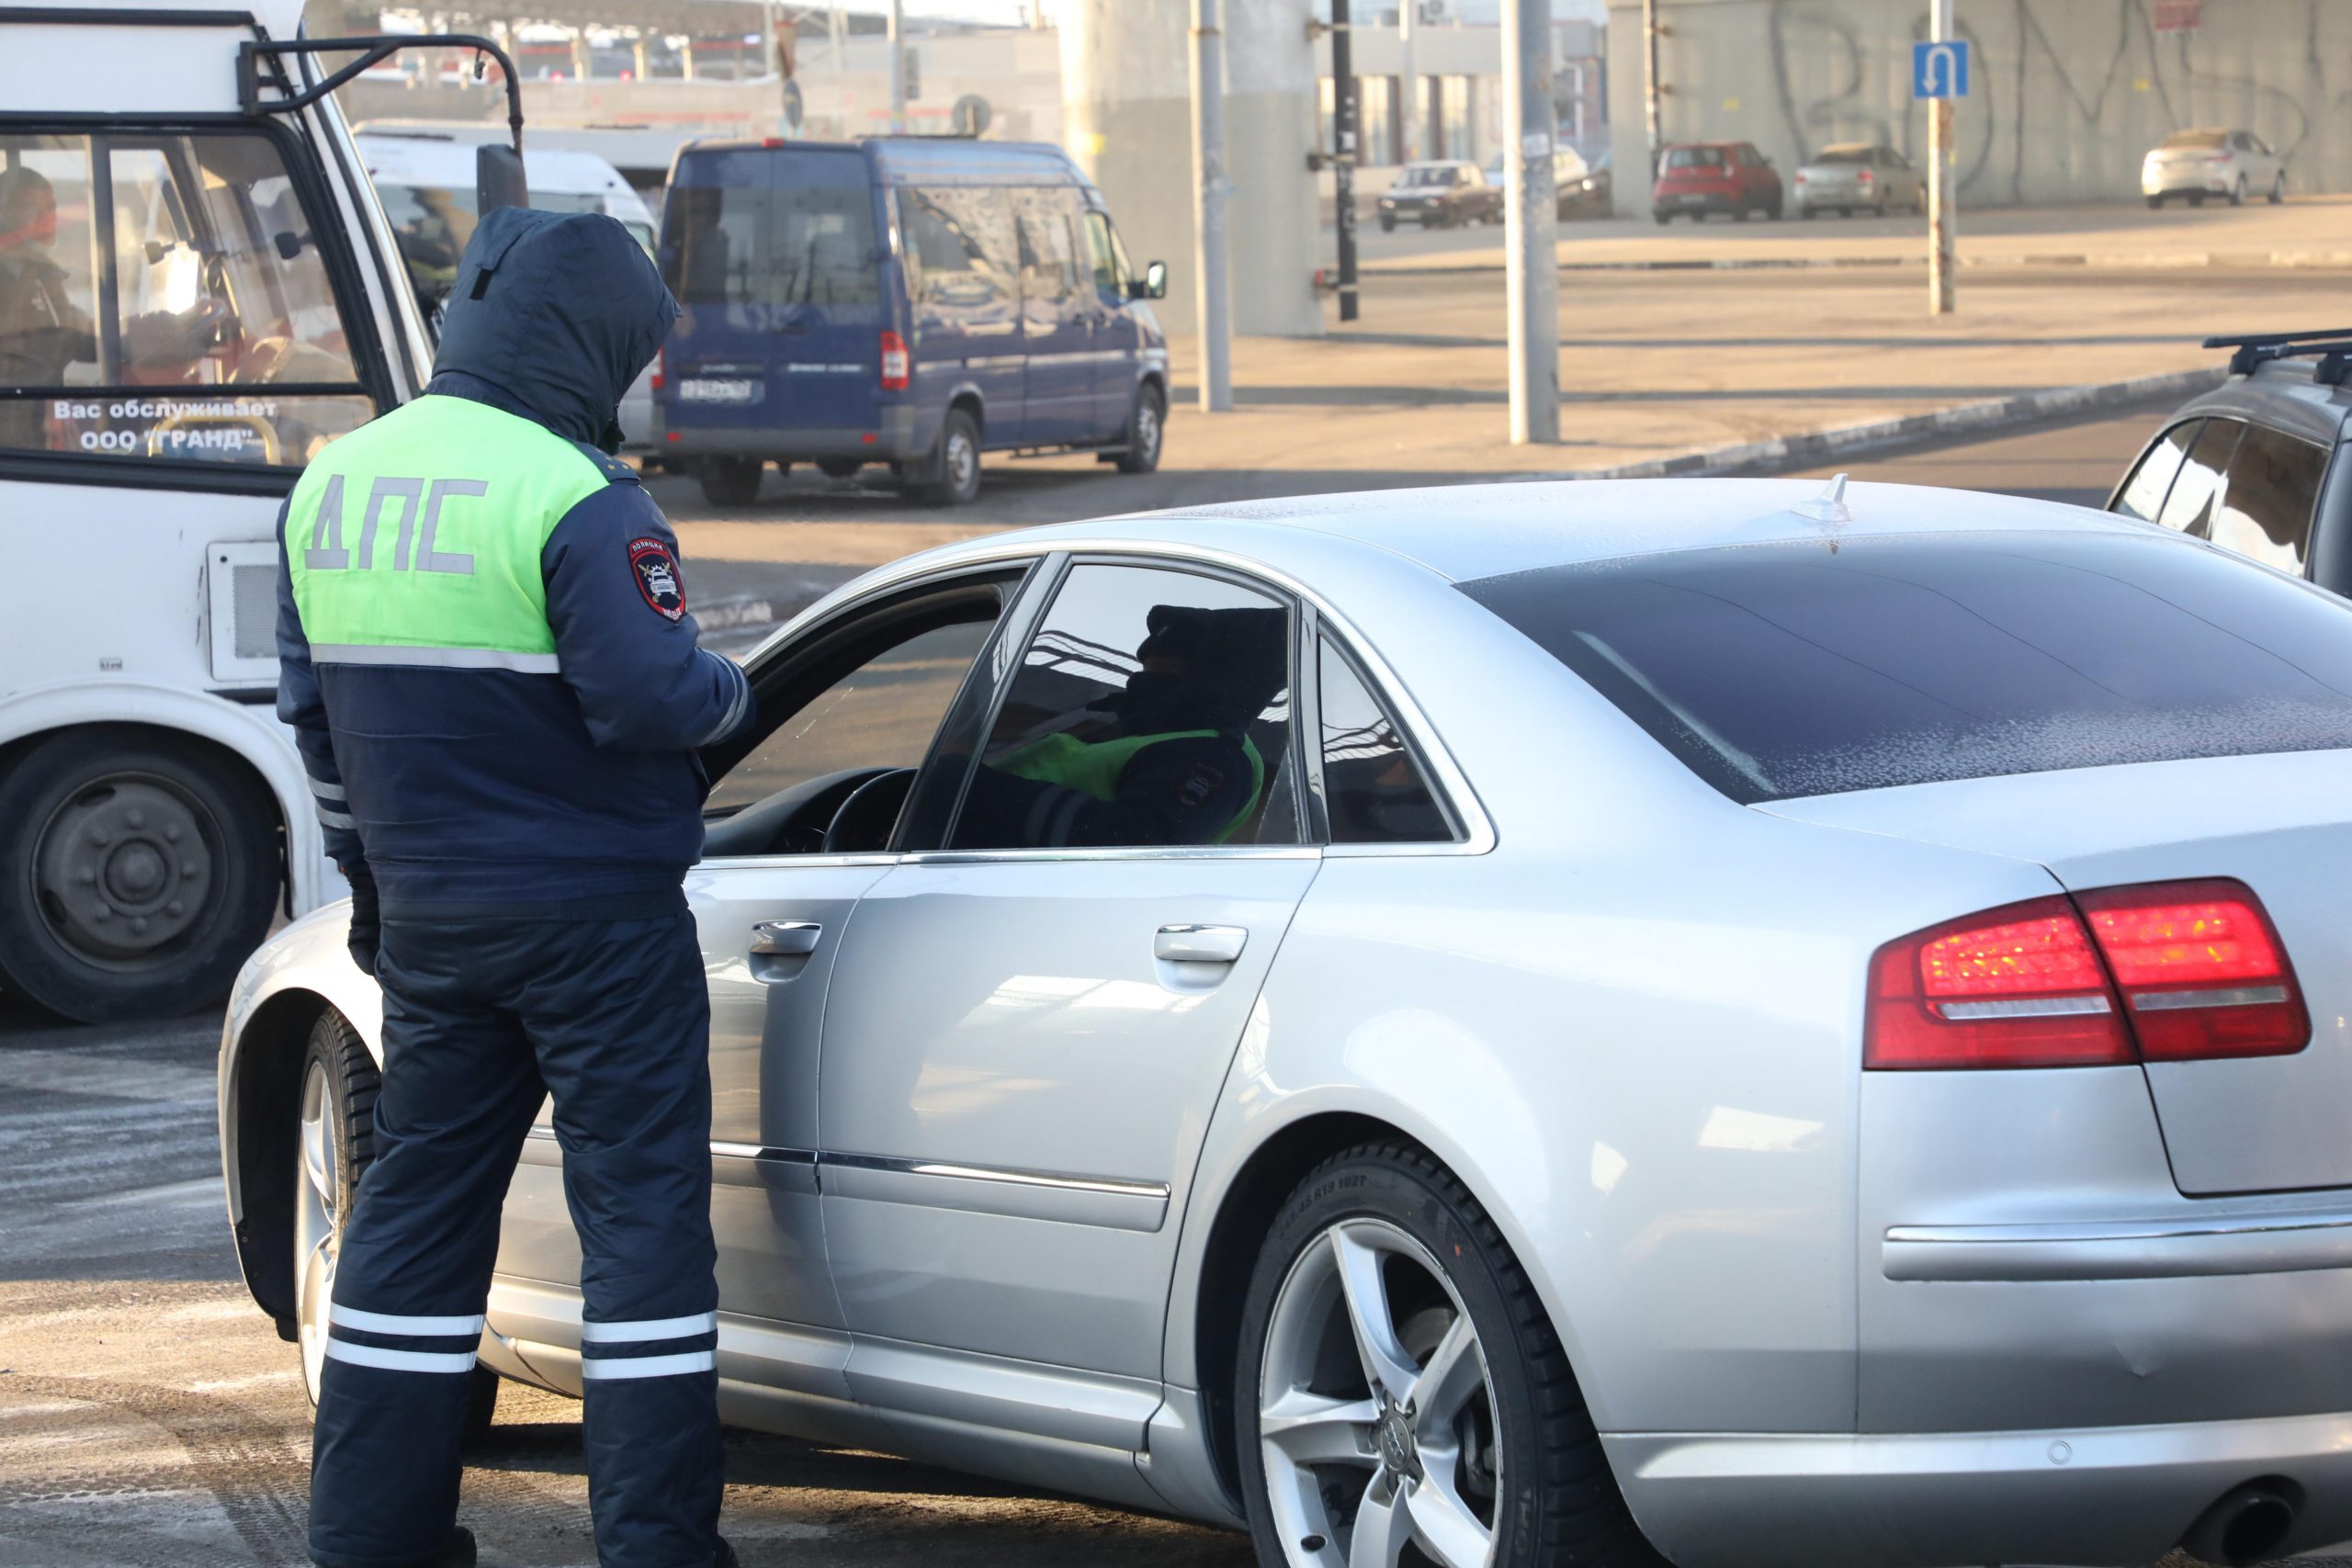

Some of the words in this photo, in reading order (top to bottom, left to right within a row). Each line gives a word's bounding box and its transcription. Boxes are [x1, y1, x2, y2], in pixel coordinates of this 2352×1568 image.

[53, 401, 102, 420] Вас
[108, 400, 277, 421] обслуживает
[80, 430, 137, 450] ООО
[143, 429, 254, 451] "ГРАНД"
[304, 474, 490, 575] ДПС
[632, 541, 663, 552] ПОЛИЦИЯ
[662, 608, 682, 620] МВД
